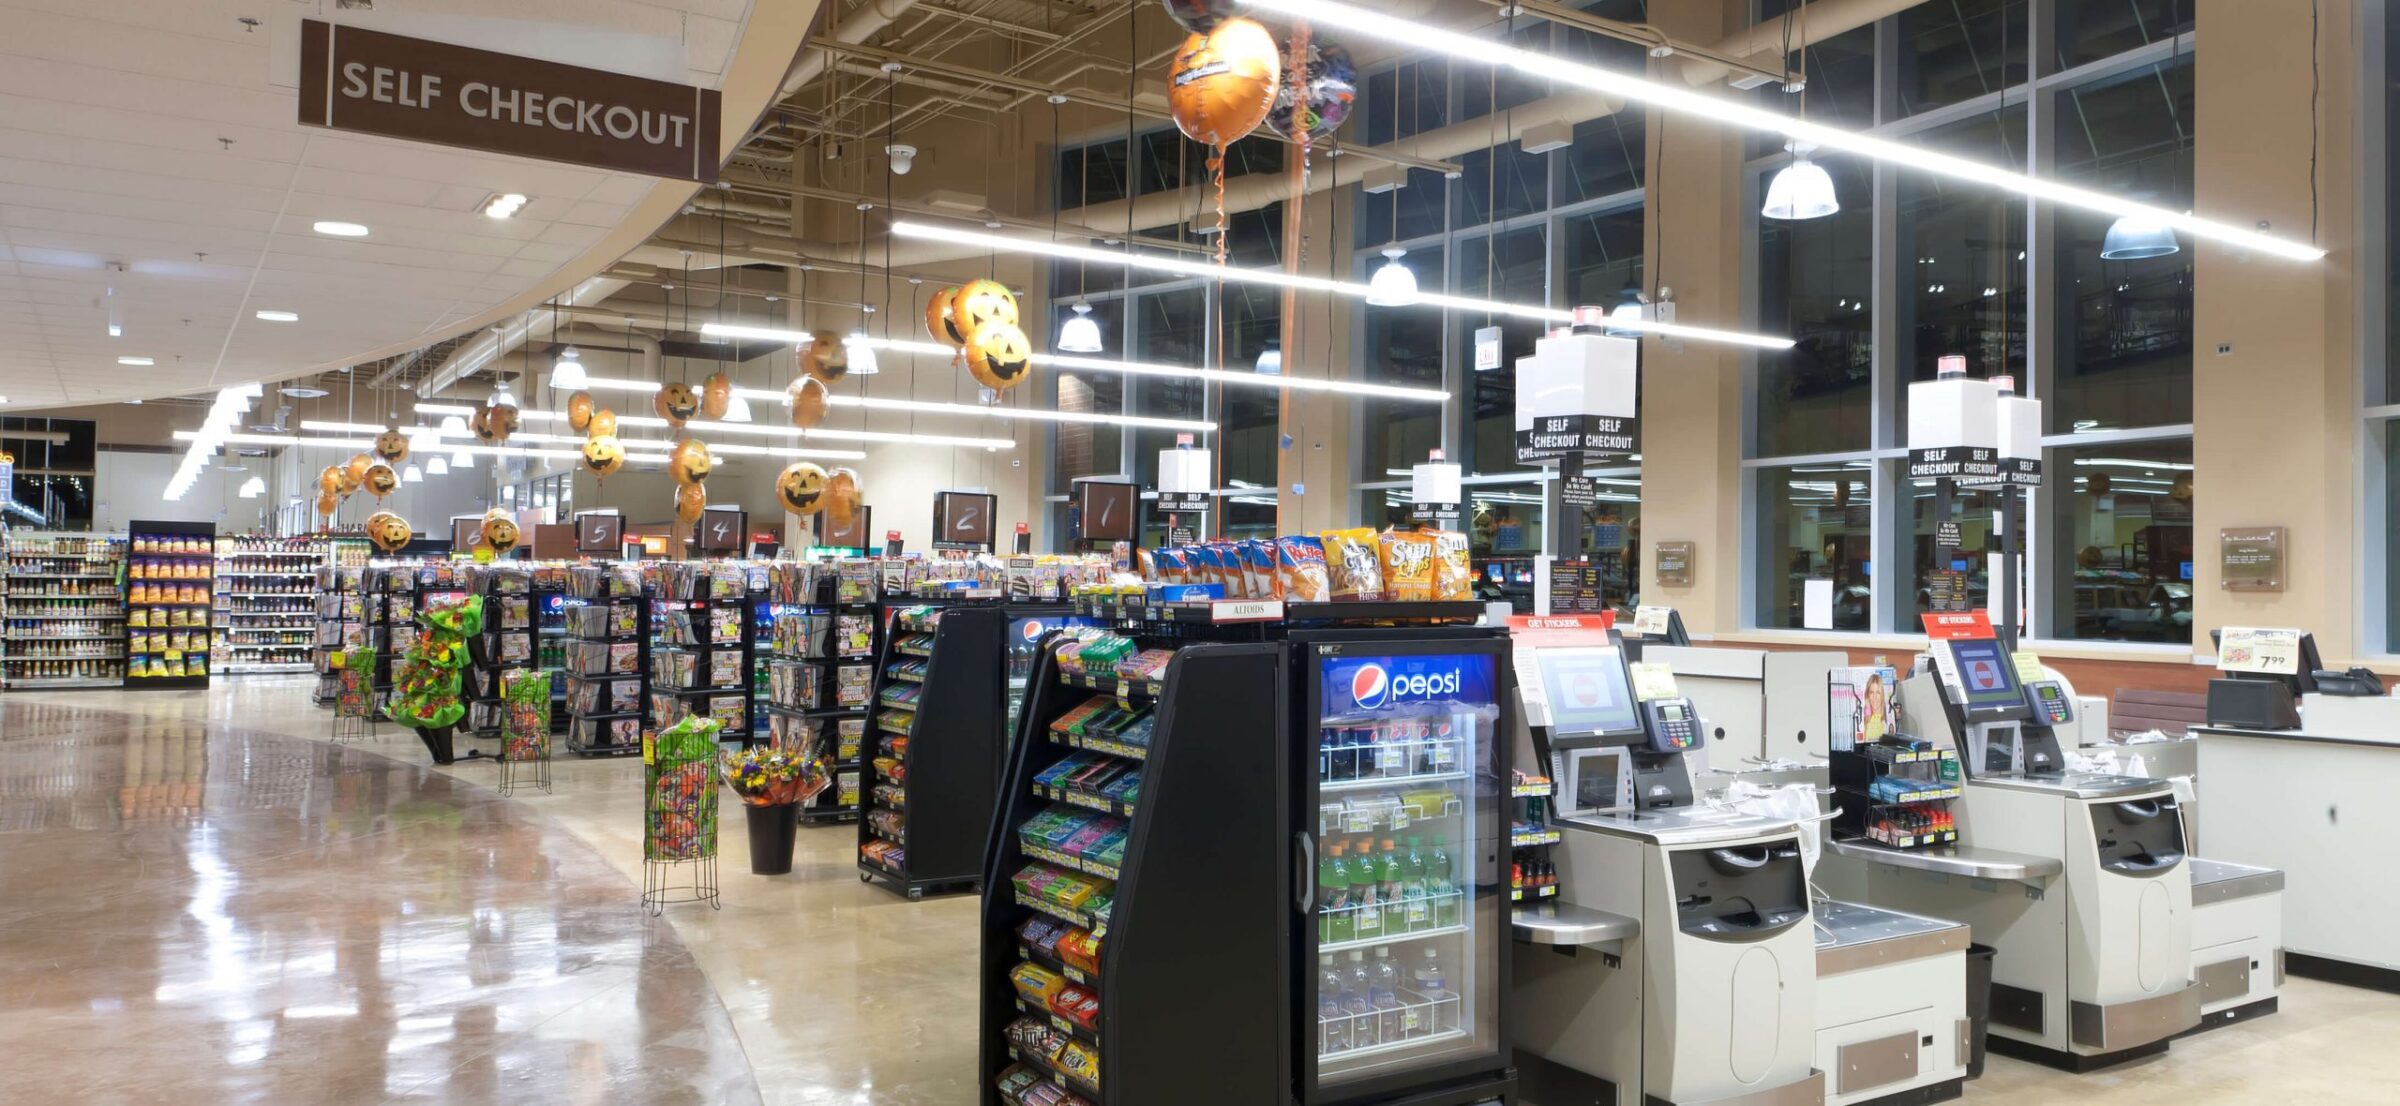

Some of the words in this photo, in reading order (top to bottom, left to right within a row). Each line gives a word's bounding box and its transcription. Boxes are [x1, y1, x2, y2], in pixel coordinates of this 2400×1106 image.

[341, 62, 441, 110] SELF
[459, 81, 689, 149] CHECKOUT
[1546, 418, 1569, 433] SELF
[1599, 418, 1621, 433] SELF
[1534, 434, 1580, 448] CHECKOUT
[1585, 434, 1633, 449] CHECKOUT
[1923, 450, 1947, 462] SELF
[1972, 450, 1989, 461] SELF
[1911, 462, 1960, 476] CHECKOUT
[1964, 462, 1998, 474] CHECKOUT
[2019, 460, 2033, 471] SELF
[2011, 472, 2041, 484] CHECKOUT
[1187, 493, 1202, 501] SELF
[1101, 497, 1116, 527] 1
[1180, 502, 1209, 510] CHECKOUT
[956, 507, 979, 530] 2
[467, 529, 481, 545] 6
[589, 524, 607, 543] 5
[712, 520, 730, 543] 4
[1390, 541, 1432, 567] Sun
[1233, 604, 1265, 615] ALTOIDS
[1527, 618, 1543, 628] GET
[1392, 667, 1461, 702] pepsi
